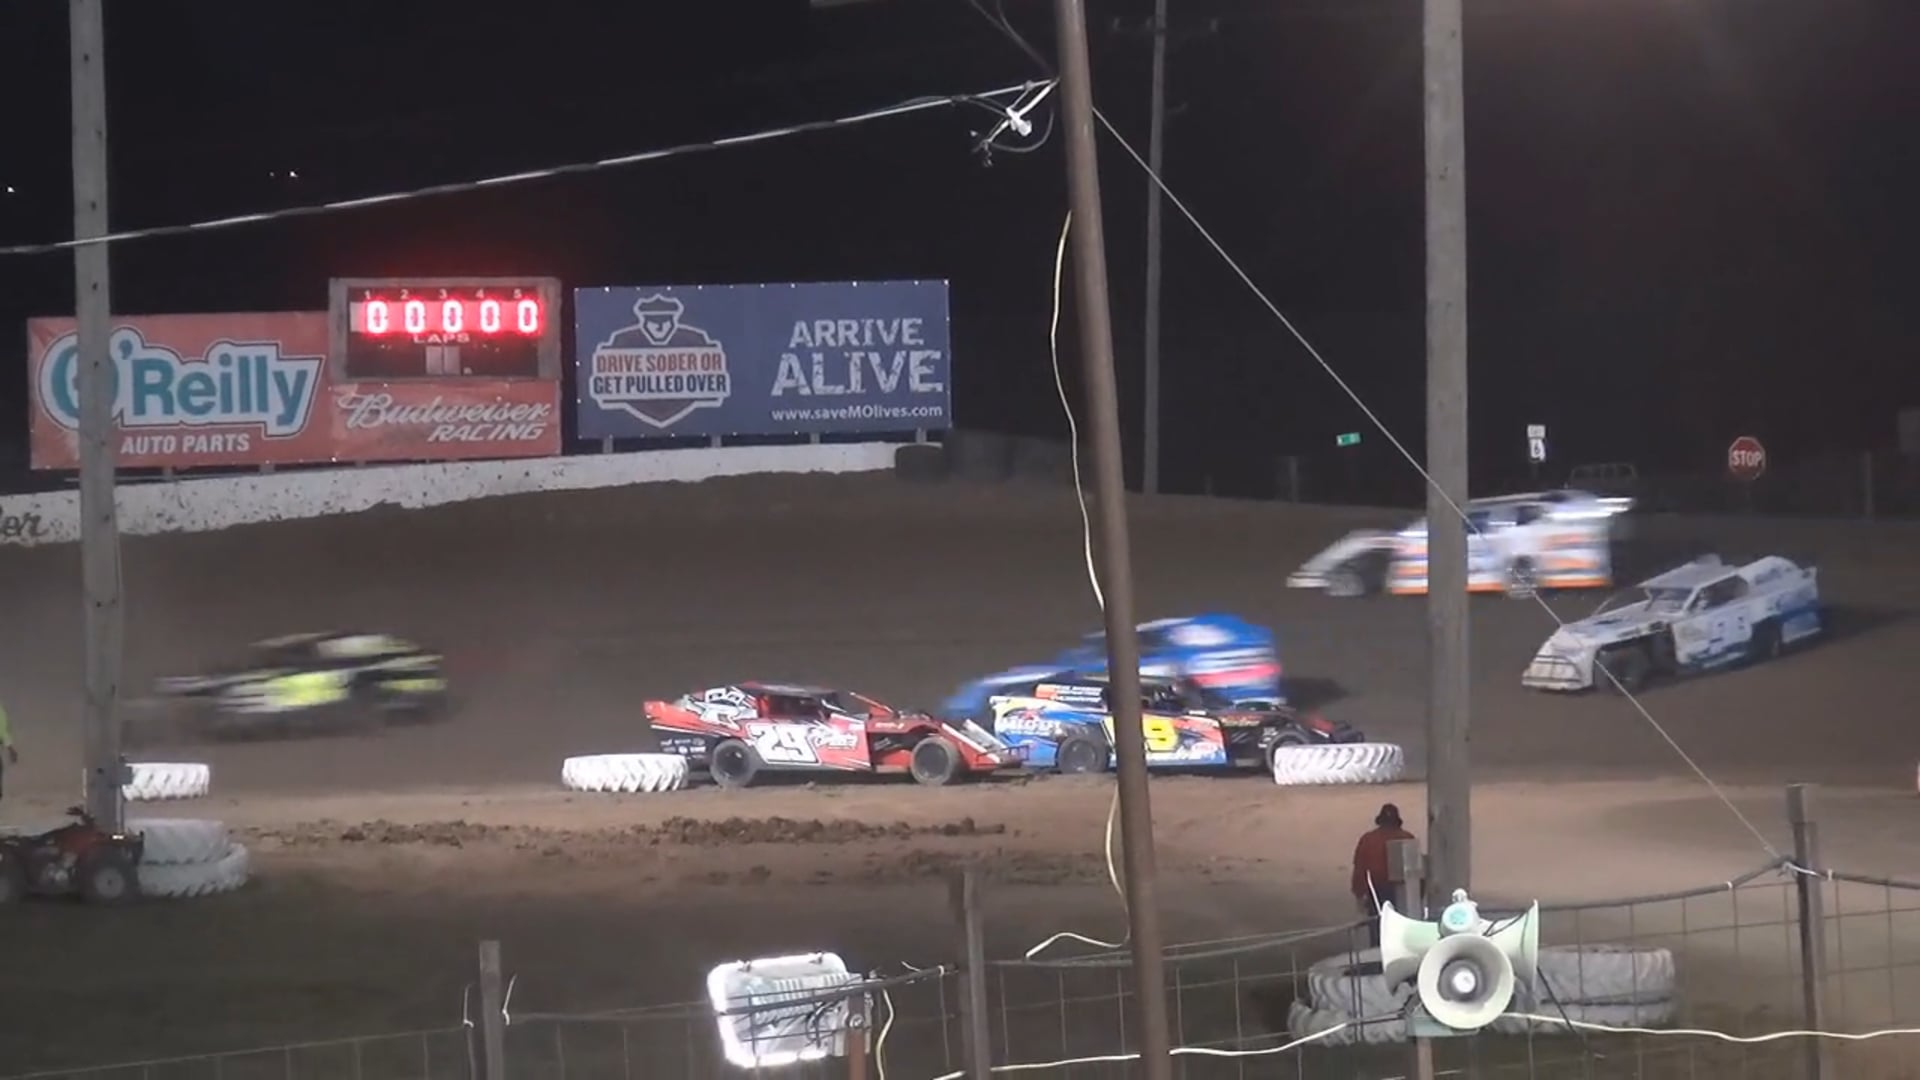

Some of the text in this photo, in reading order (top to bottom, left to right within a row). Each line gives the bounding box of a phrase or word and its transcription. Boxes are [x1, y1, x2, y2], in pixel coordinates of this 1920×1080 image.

[400, 289, 409, 299] 2
[439, 289, 447, 299] 3
[476, 289, 484, 298] 4
[513, 289, 522, 298] 5
[413, 334, 470, 344] LAPS
[788, 318, 925, 348] ARRIVE
[596, 351, 722, 373] DRIVE SOBER OR
[593, 373, 727, 395] GET PULLED OVER
[771, 350, 943, 397] ALIVE
[338, 392, 552, 429] Budweiser
[771, 405, 943, 421] www.saveMOlives.com
[428, 423, 547, 442] RACING
[121, 434, 250, 454] AUTO PARTS
[1732, 450, 1763, 467] STOP
[0, 505, 49, 537] er
[748, 723, 818, 762] 29
